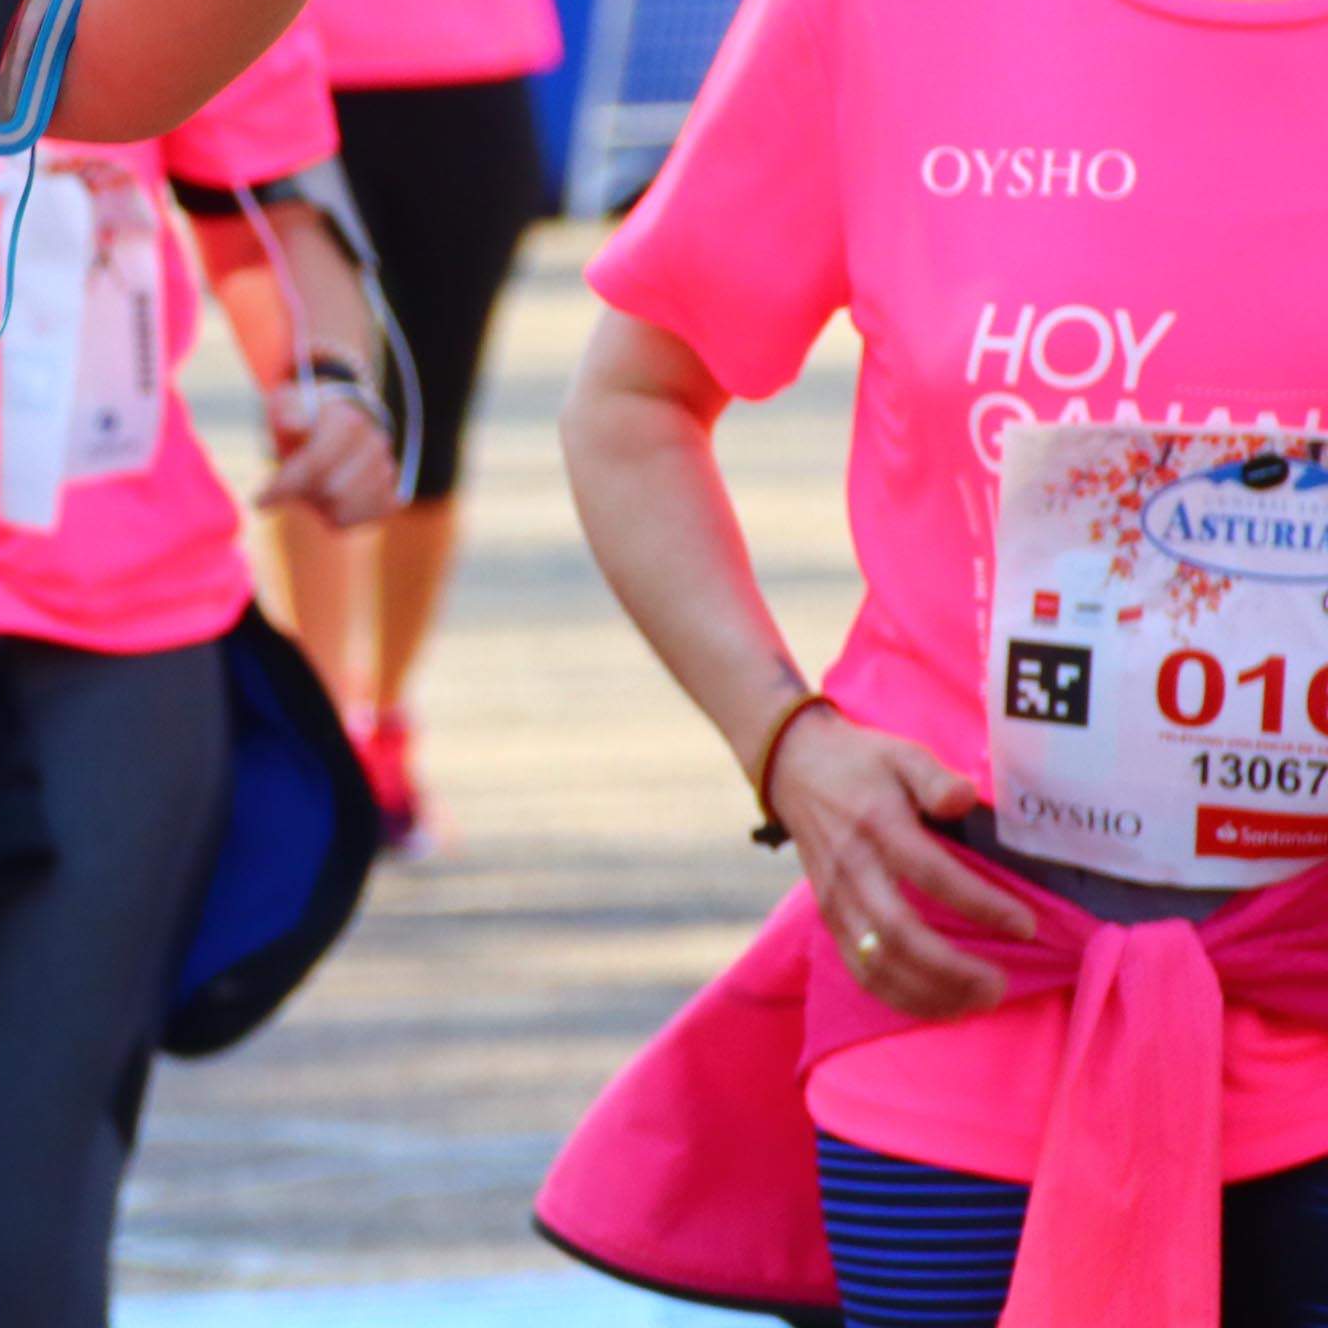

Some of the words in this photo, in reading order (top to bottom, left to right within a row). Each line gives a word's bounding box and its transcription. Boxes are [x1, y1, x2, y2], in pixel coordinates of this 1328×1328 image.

[922, 145, 1136, 201] OYSHO
[965, 303, 1177, 391] HOY
[1018, 791, 1141, 838] OYSHO
